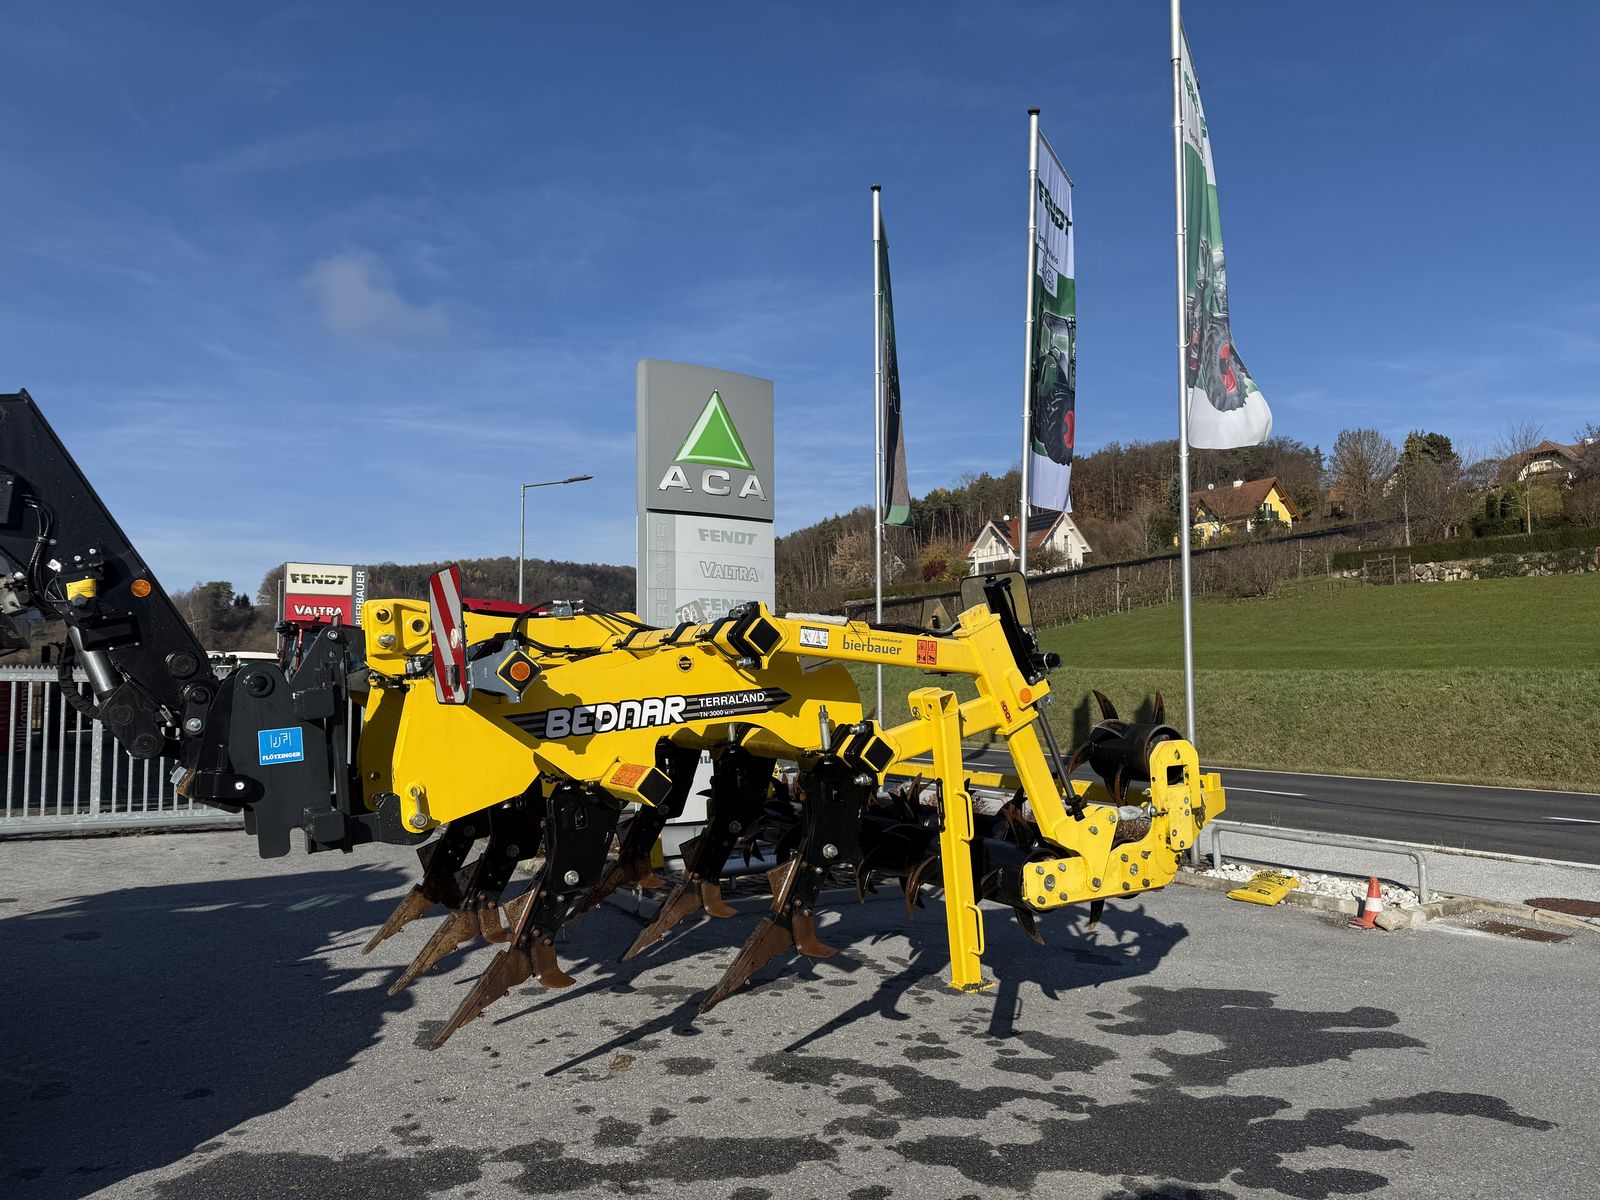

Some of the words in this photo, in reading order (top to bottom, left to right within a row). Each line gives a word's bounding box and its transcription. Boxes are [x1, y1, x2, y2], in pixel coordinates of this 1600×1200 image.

[658, 465, 767, 502] ACA
[698, 528, 758, 545] FENDT
[290, 573, 348, 586] FENDT
[356, 570, 365, 625] BIERBAUER
[699, 598, 752, 612] FEN
[293, 604, 343, 617] VALTRA
[842, 634, 902, 655] bierbauer
[698, 692, 765, 708] TERRALAND
[545, 696, 687, 739] BEDNAR
[709, 709, 724, 717] 3000
